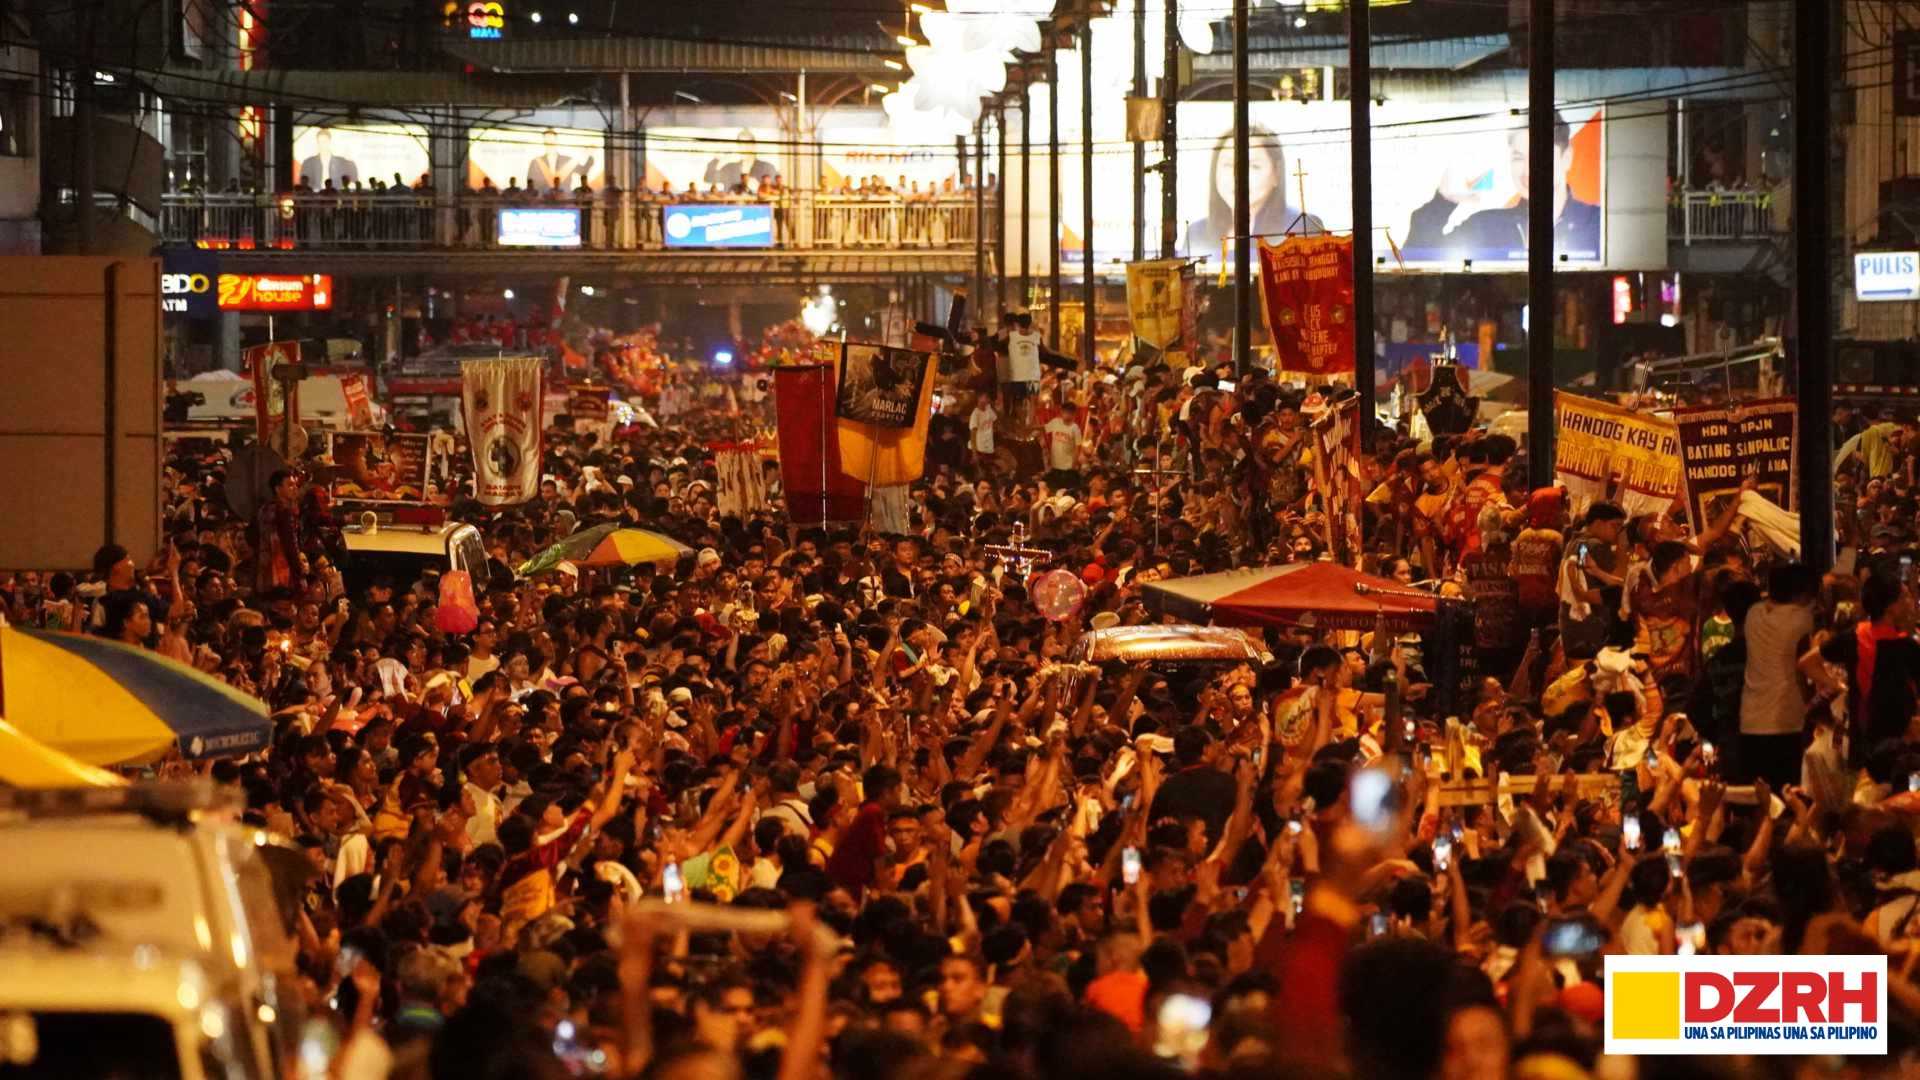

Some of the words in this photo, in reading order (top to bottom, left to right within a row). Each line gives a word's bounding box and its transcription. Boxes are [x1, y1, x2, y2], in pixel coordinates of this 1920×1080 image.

[1860, 256, 1913, 275] PULIS
[162, 274, 209, 294] BDO
[252, 284, 302, 303] house
[1562, 409, 1625, 441] HANDOG
[1626, 426, 1659, 451] KAY
[1687, 443, 1732, 460] BATANG
[1736, 436, 1790, 457] SAMPALOC
[1688, 465, 1737, 479] HANDOG
